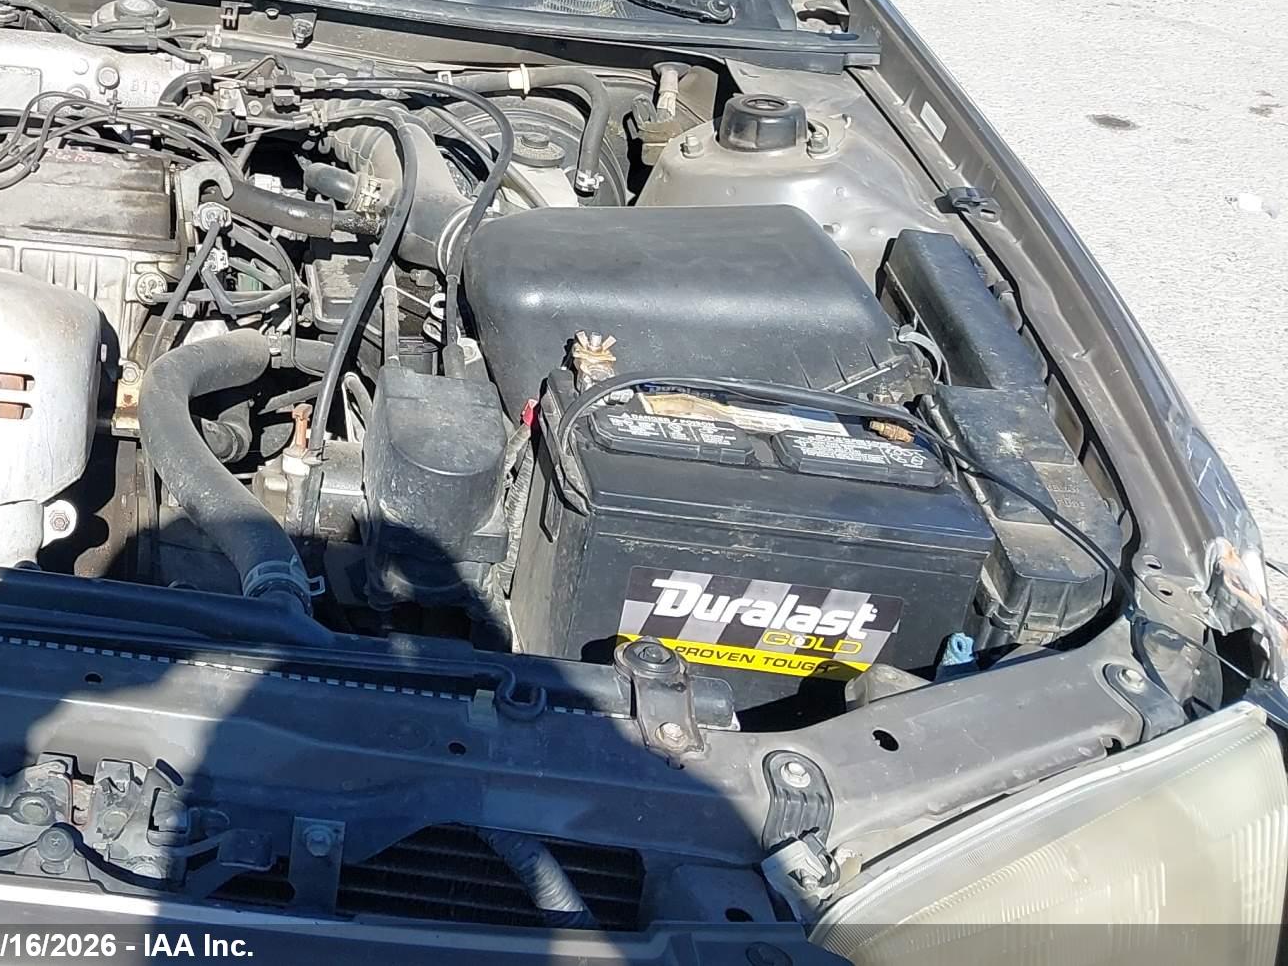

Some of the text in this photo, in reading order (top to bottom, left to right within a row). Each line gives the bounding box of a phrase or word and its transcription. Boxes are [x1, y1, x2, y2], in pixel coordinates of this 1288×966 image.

[651, 578, 878, 640] Duralast
[762, 631, 863, 654] GOLD
[674, 645, 830, 674] PROVEN TOUGH
